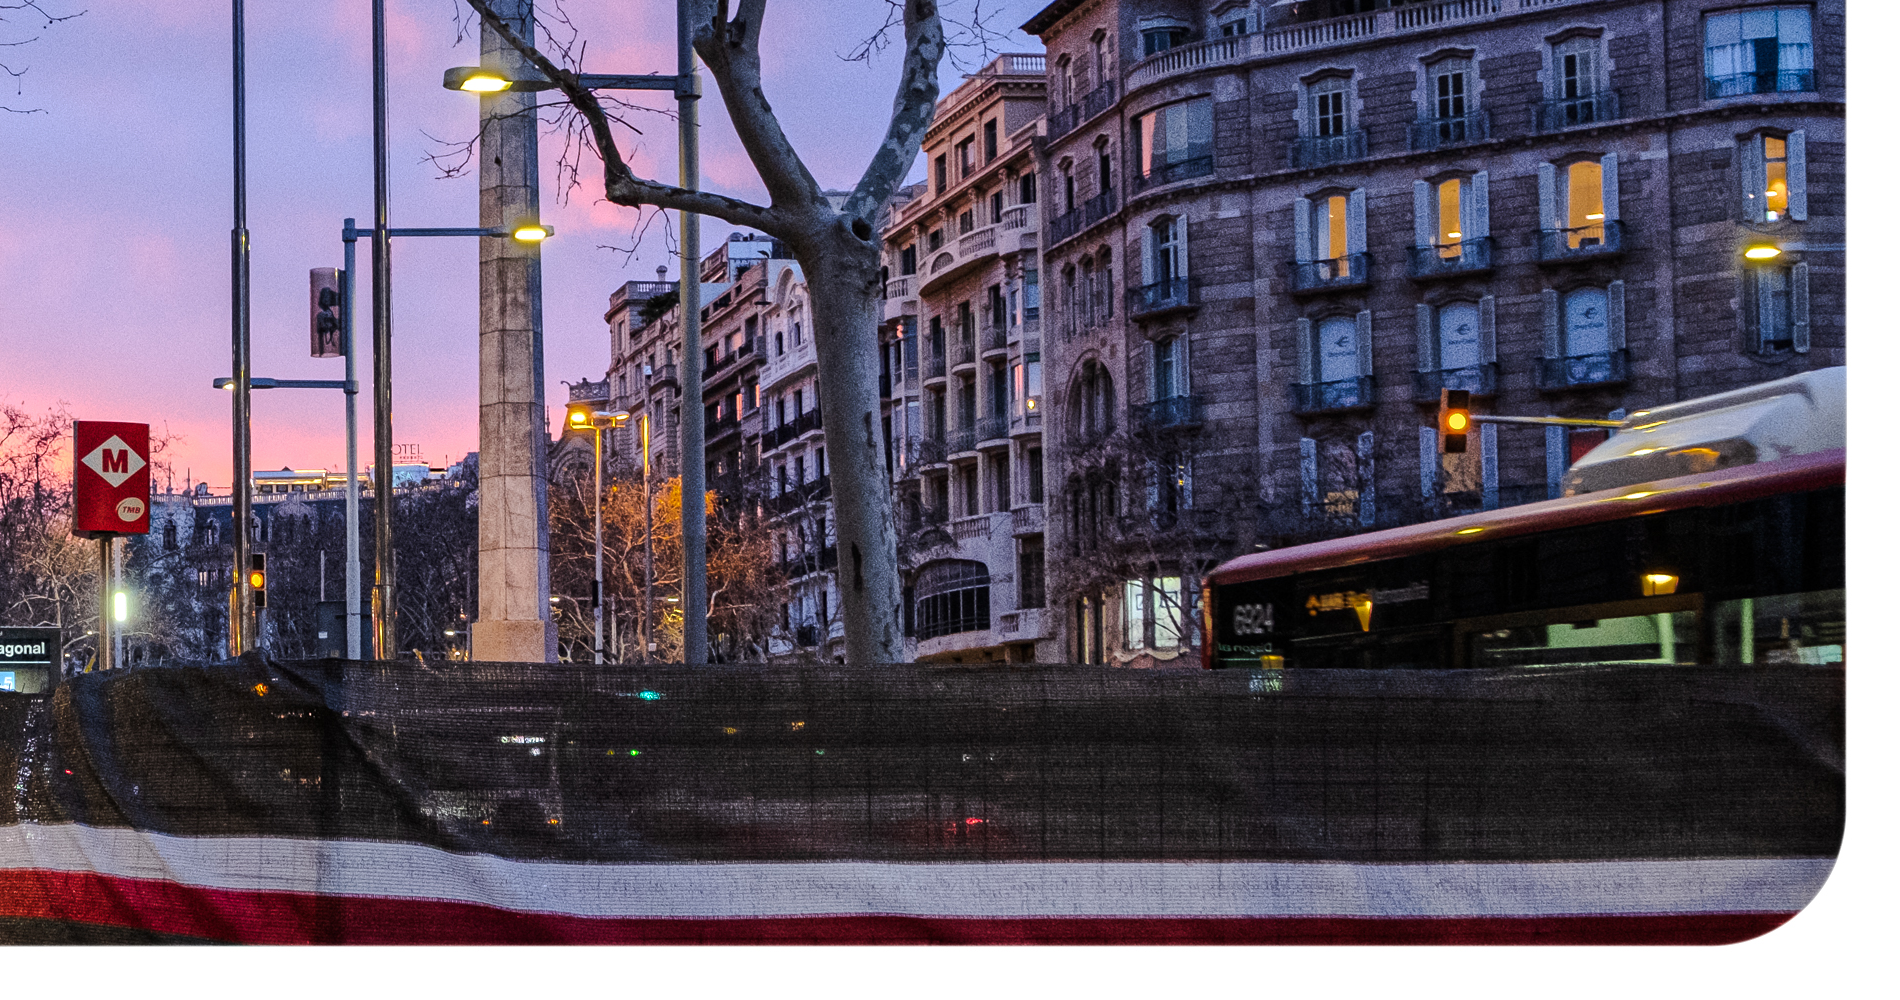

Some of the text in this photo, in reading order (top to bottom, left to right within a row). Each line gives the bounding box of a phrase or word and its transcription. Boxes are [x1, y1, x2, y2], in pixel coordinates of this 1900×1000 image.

[391, 443, 424, 456] OTEL
[102, 448, 129, 474] M
[122, 506, 141, 514] TMB
